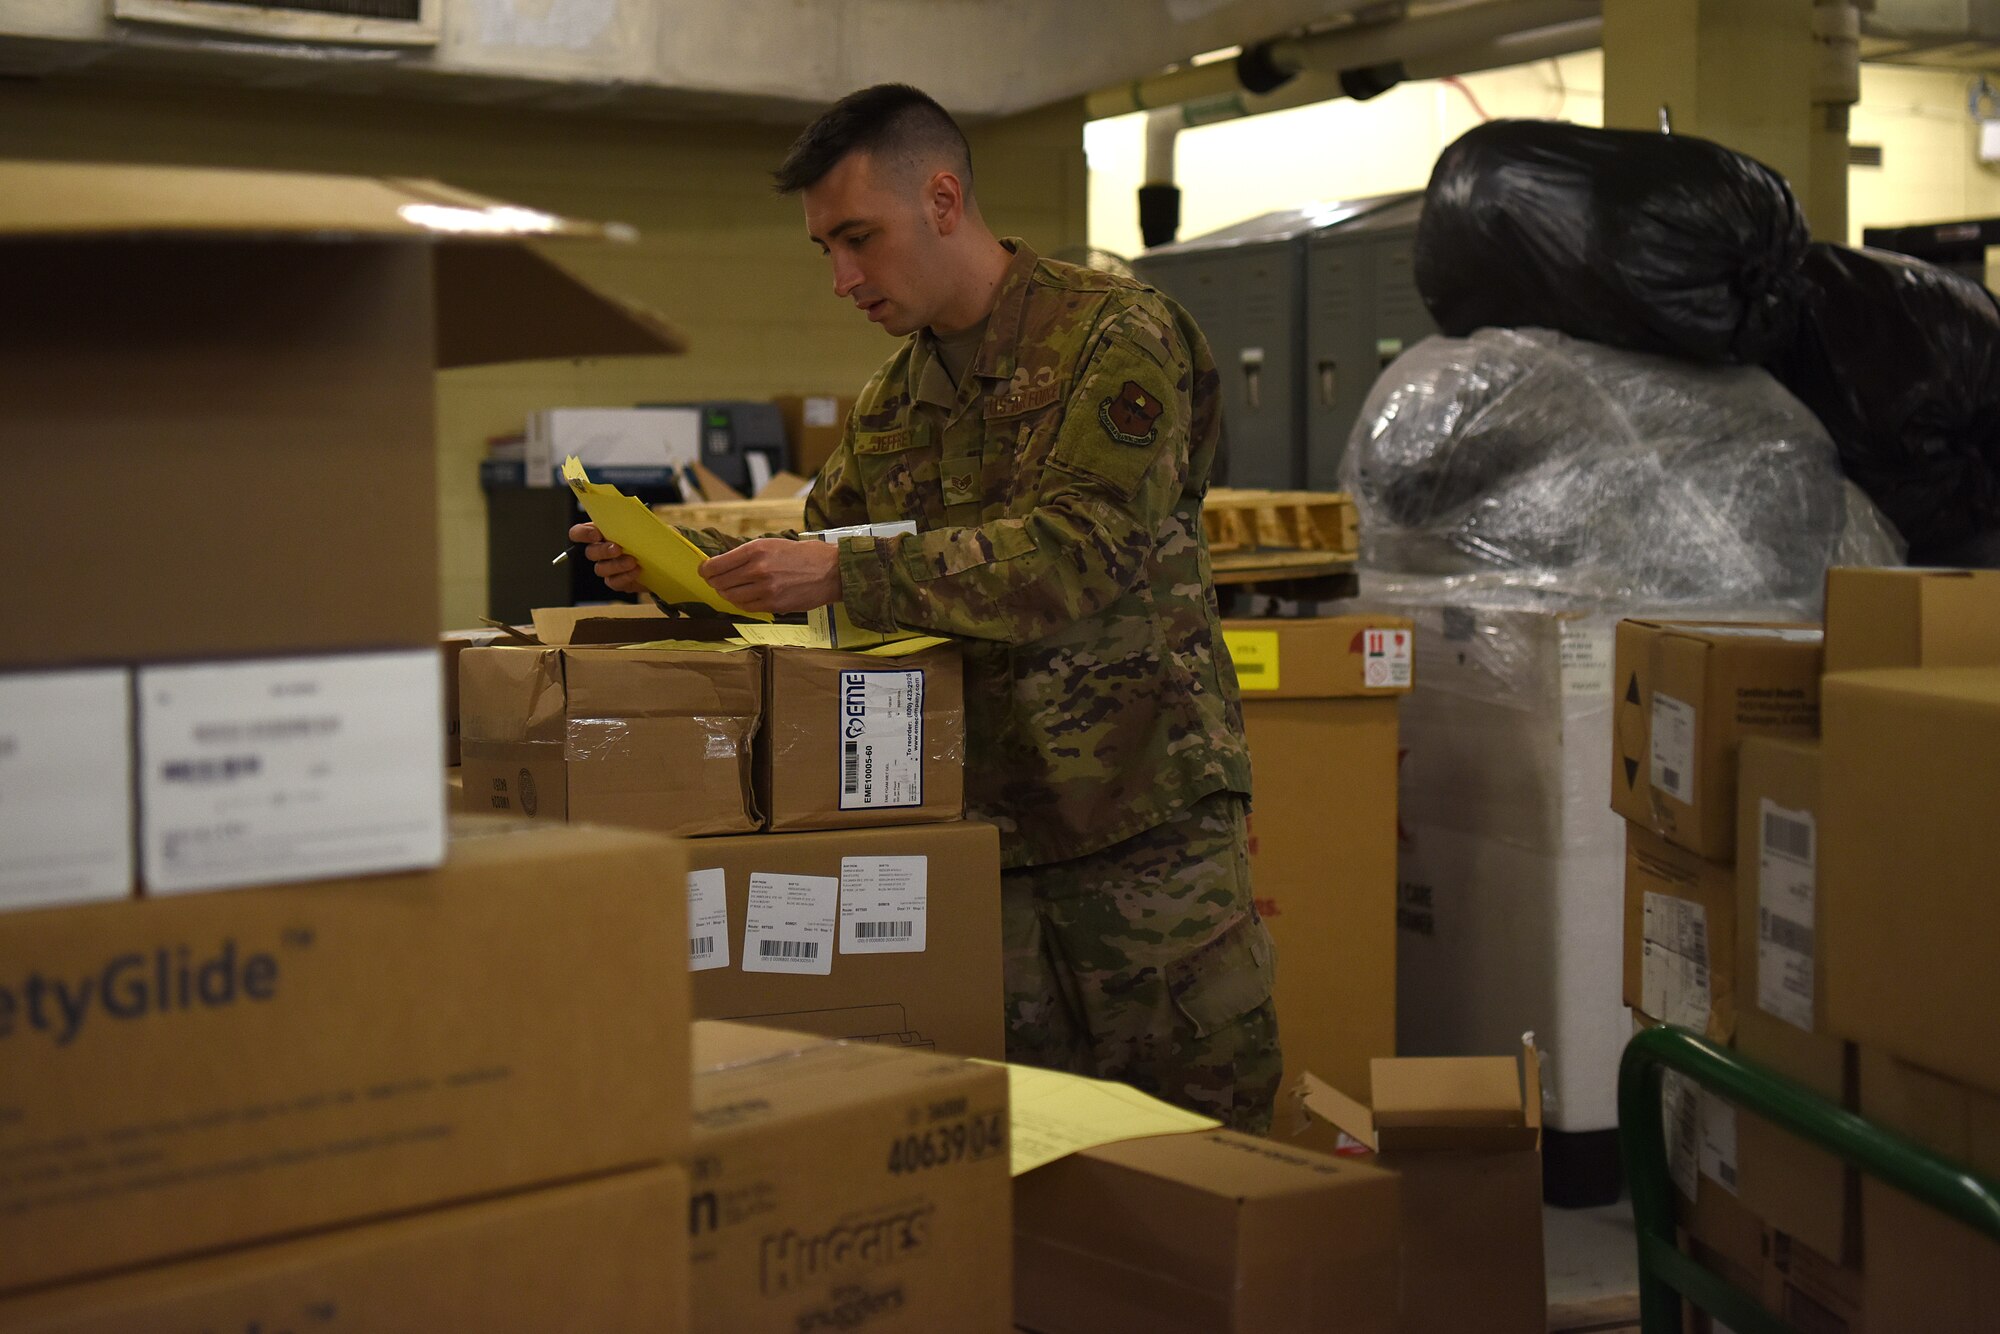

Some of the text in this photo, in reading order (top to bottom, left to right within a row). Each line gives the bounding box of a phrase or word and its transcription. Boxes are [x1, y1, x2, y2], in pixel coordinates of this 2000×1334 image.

[1028, 383, 1059, 407] FORCE
[872, 428, 915, 452] JEFFREY
[846, 674, 866, 717] EME
[906, 747, 912, 757] To
[864, 745, 873, 804] EME10005-60
[888, 1124, 967, 1177] 40639
